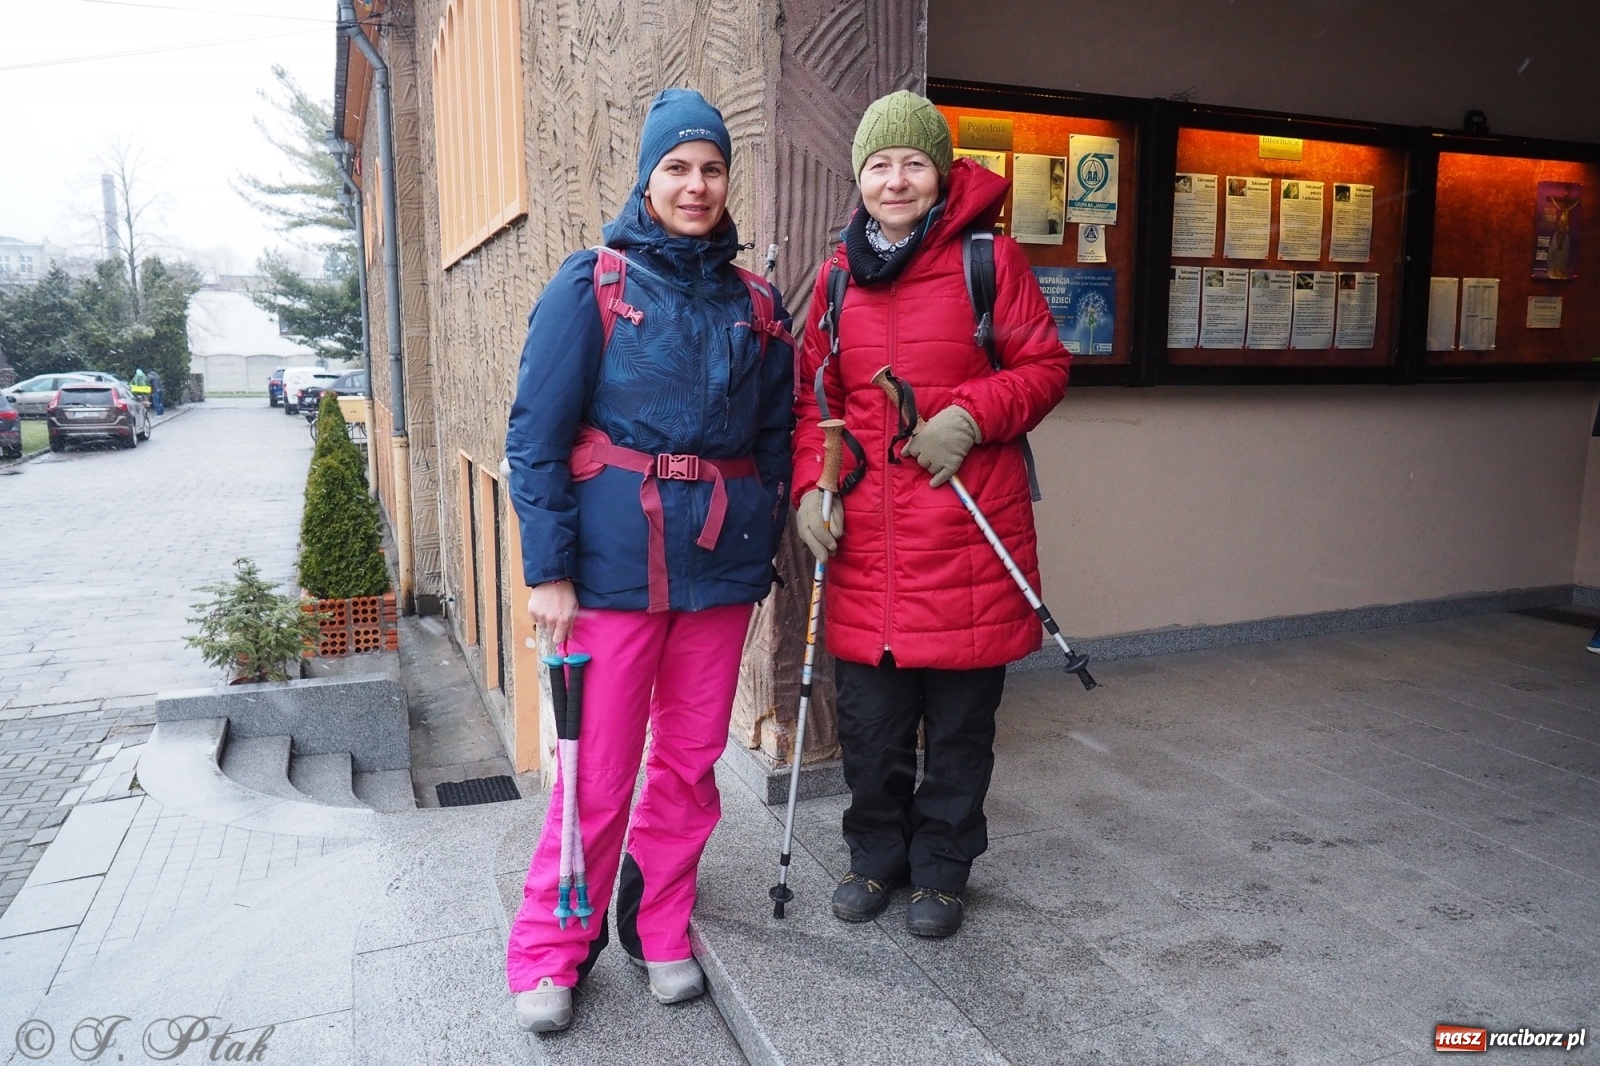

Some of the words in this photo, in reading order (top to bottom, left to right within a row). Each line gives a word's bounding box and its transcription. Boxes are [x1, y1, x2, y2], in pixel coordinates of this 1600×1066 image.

[967, 121, 1006, 133] Poradnia
[1038, 276, 1070, 285] WSPARCIA
[1051, 296, 1071, 304] DZIECI
